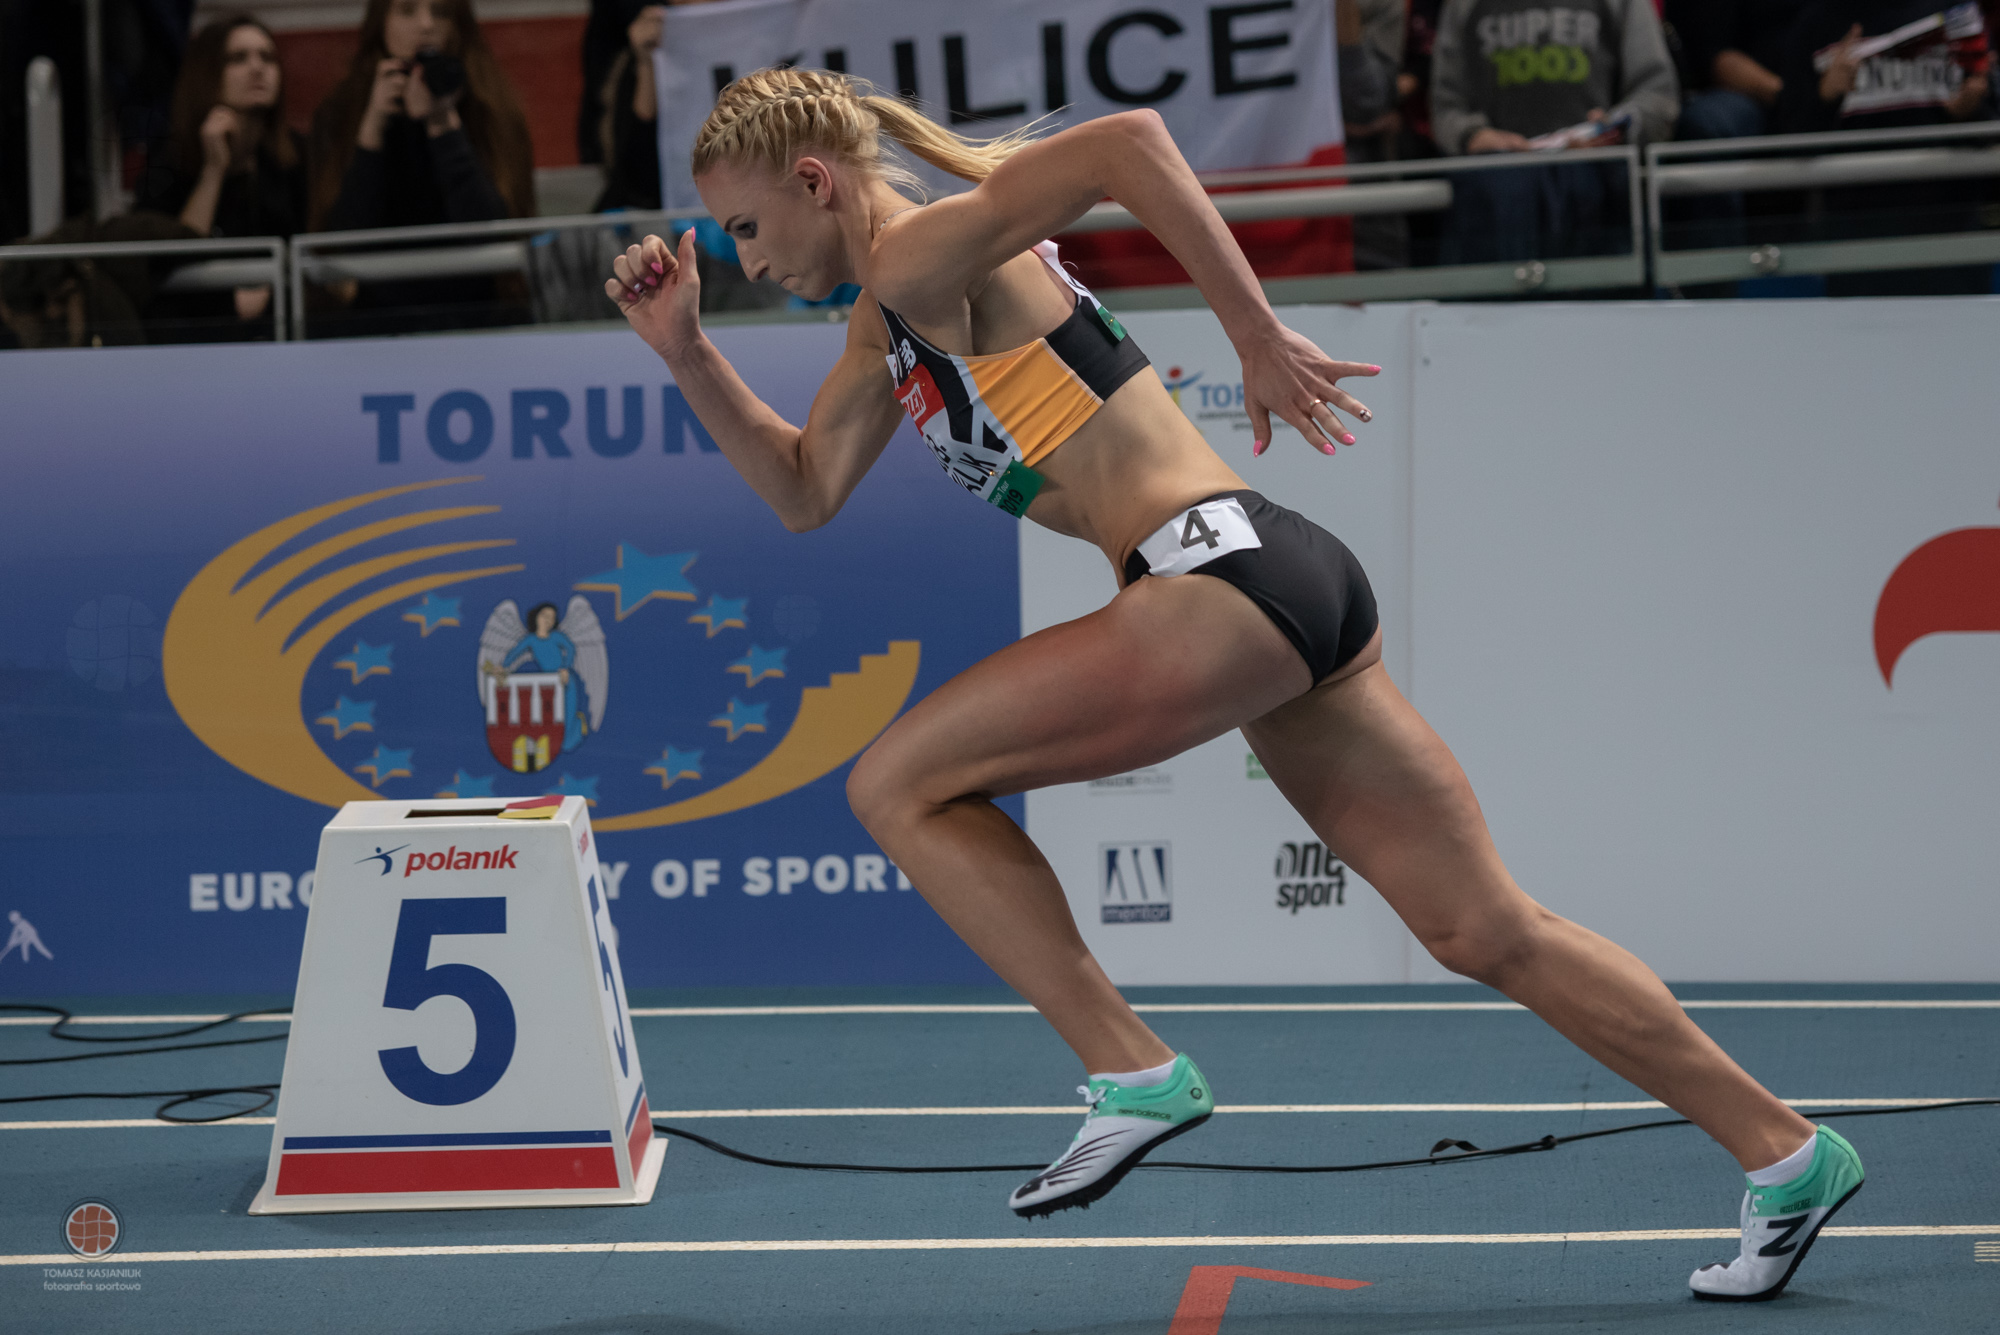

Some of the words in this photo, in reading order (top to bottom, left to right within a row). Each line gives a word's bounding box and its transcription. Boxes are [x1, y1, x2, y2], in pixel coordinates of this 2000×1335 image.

[1180, 508, 1221, 549] 4
[404, 844, 519, 878] polanik
[651, 859, 721, 899] OF
[1102, 906, 1170, 922] mentor
[1276, 879, 1345, 915] sport
[378, 896, 517, 1106] 5
[1117, 1108, 1136, 1116] new
[1136, 1108, 1172, 1120] balance
